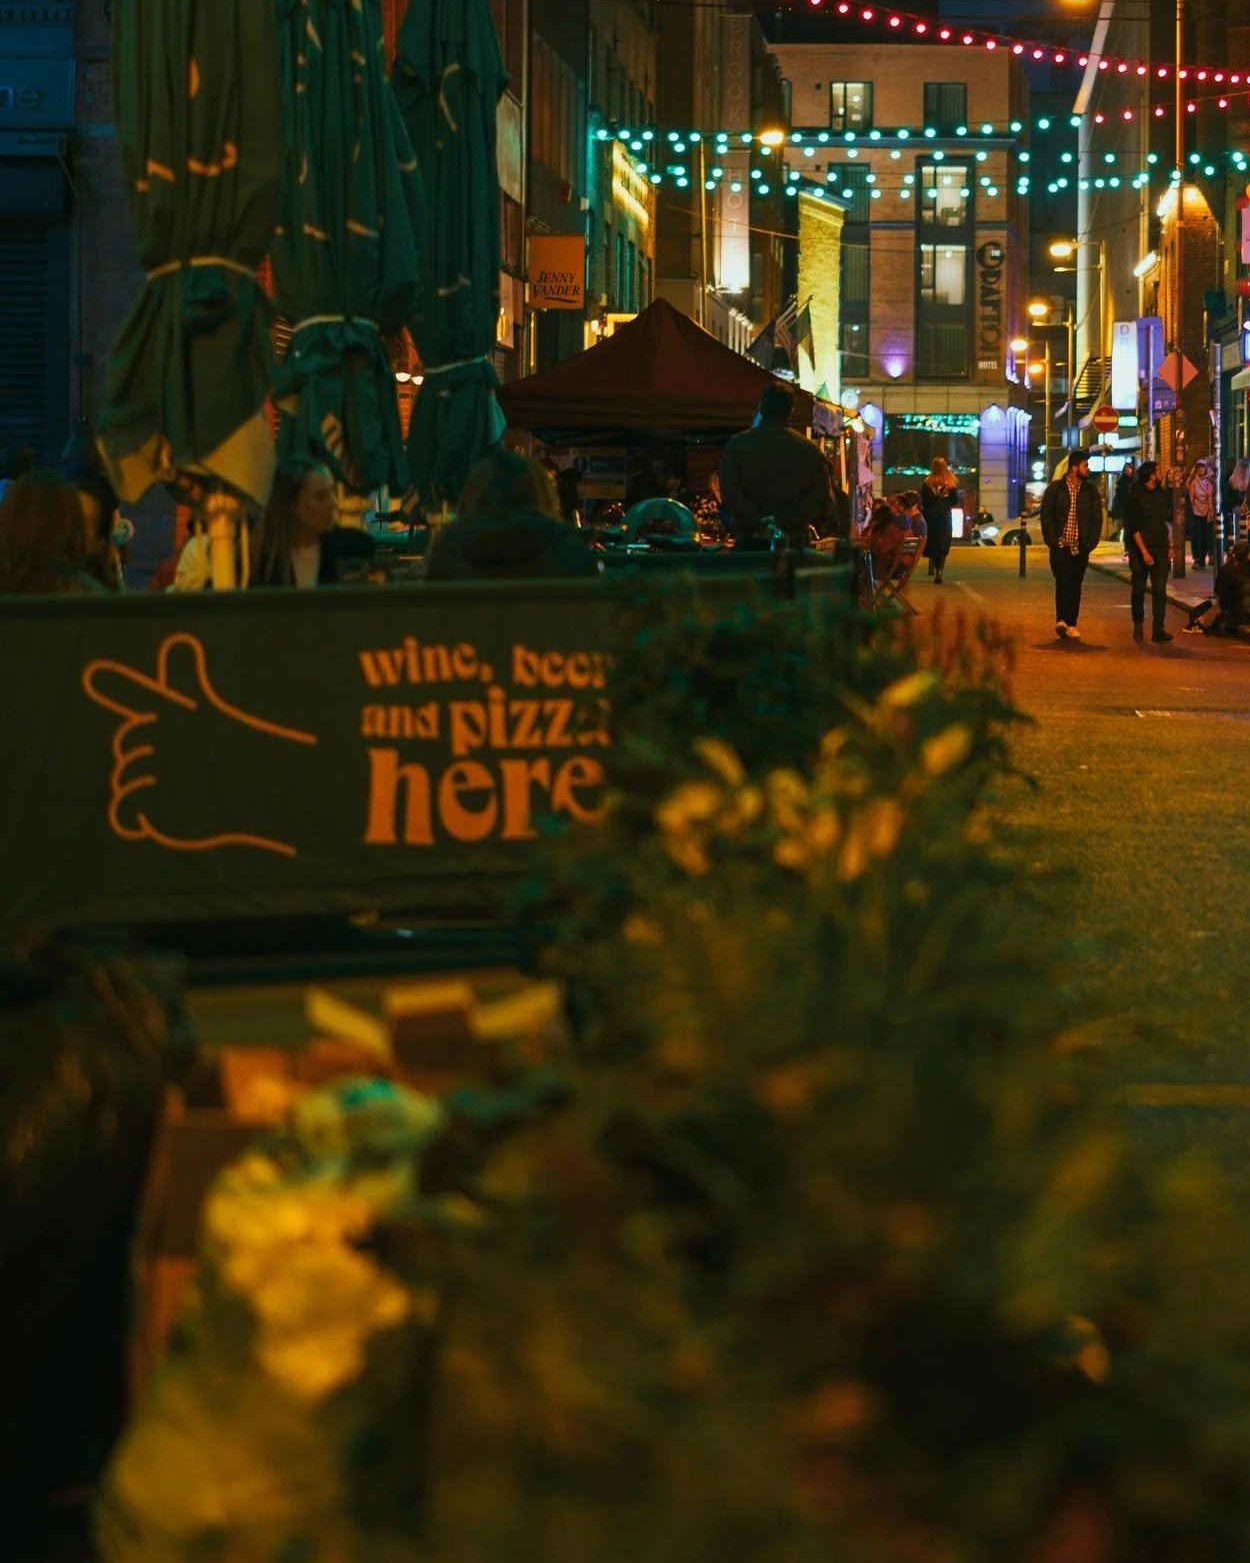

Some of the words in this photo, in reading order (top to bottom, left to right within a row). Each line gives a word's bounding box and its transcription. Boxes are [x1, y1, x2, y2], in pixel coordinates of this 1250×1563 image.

[539, 271, 577, 283] JENNY
[533, 284, 580, 297] VANDER
[978, 360, 998, 370] HOTEL
[358, 634, 496, 687] wine,
[361, 701, 440, 739] and
[364, 746, 614, 845] here
